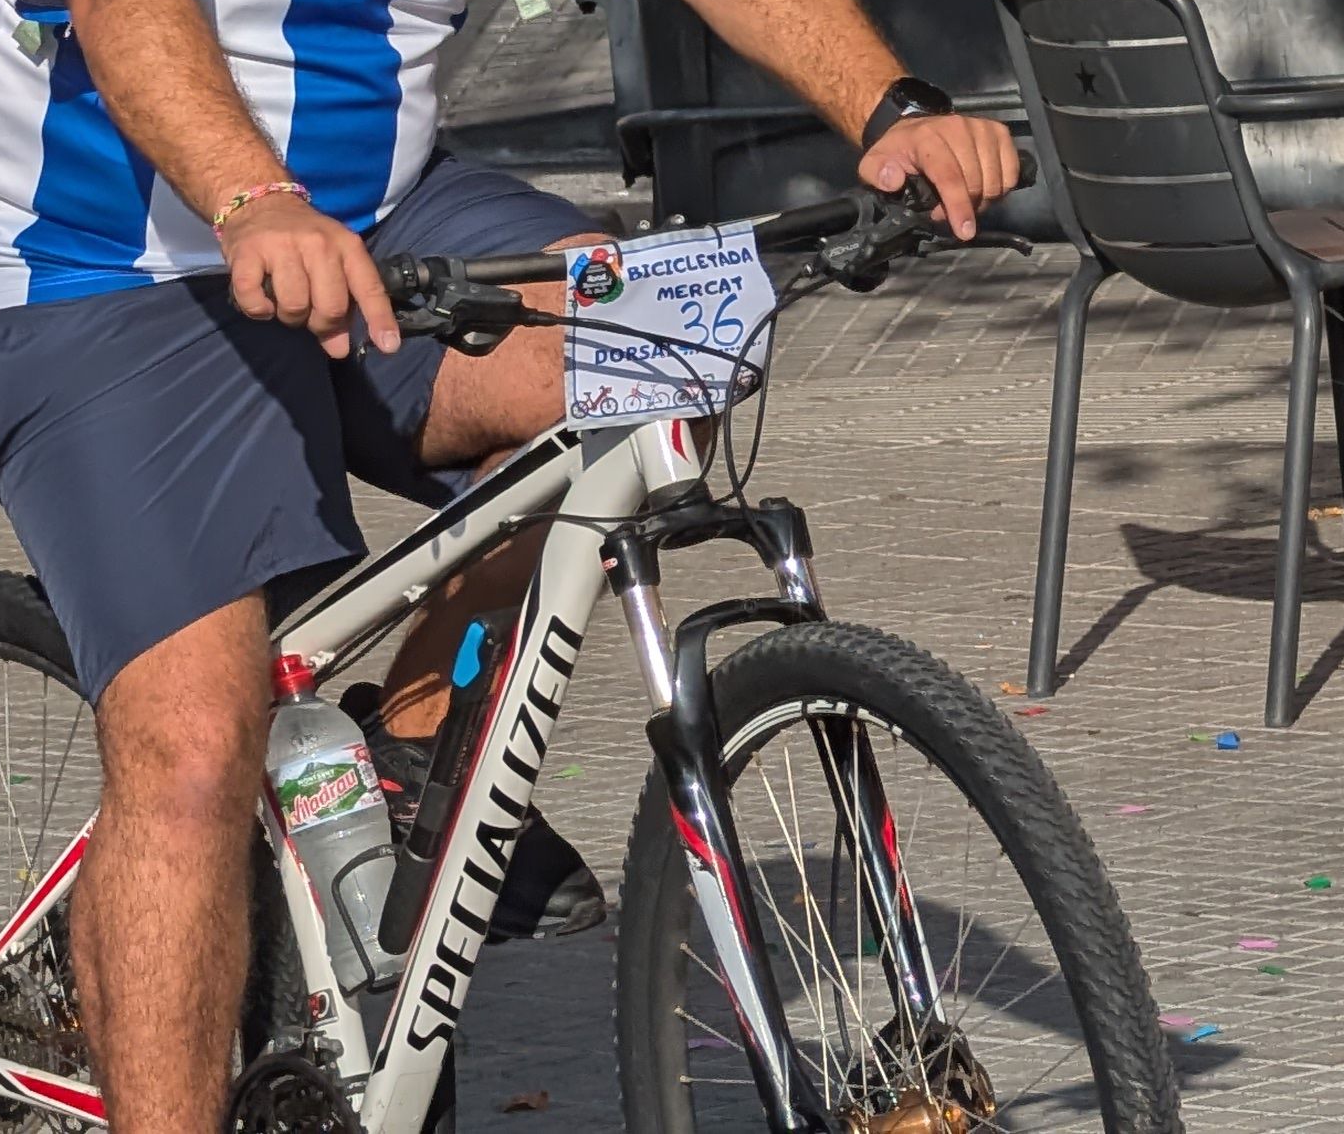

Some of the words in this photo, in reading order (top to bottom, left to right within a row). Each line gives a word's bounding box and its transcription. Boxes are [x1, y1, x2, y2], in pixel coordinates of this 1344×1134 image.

[627, 247, 754, 282] BICICLETADA
[656, 275, 743, 301] MERCAT
[680, 292, 744, 347] 36
